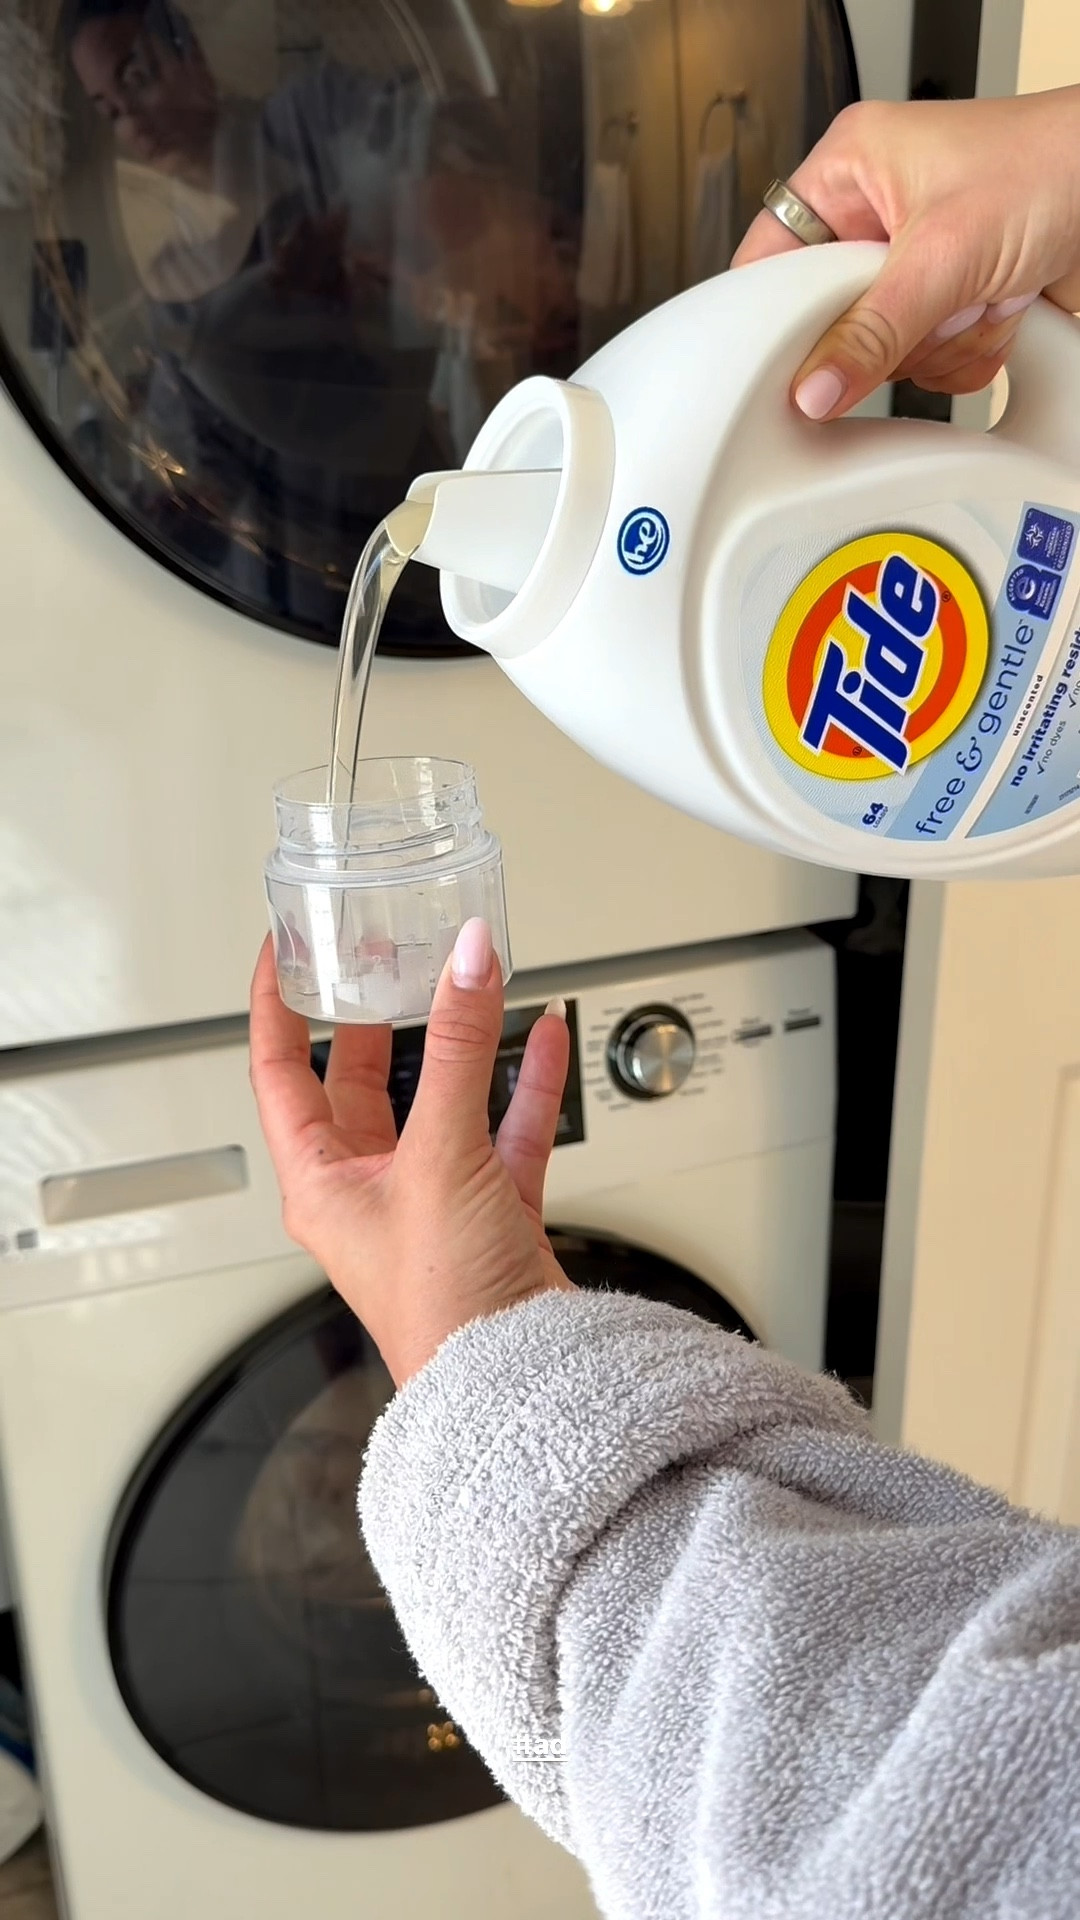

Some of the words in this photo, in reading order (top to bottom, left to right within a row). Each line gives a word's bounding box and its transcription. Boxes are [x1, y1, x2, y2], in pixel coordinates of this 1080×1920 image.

[623, 520, 657, 563] he
[801, 553, 938, 772] Tide
[915, 778, 965, 835] free
[956, 736, 983, 772] &
[978, 624, 1034, 735] gentle
[1010, 765, 1028, 787] no
[1021, 682, 1068, 761] irritating
[1062, 627, 1080, 678] resid
[1012, 674, 1044, 737] unscented
[1042, 749, 1053, 764] no
[1050, 720, 1067, 747] dyes
[862, 802, 884, 825] 64
